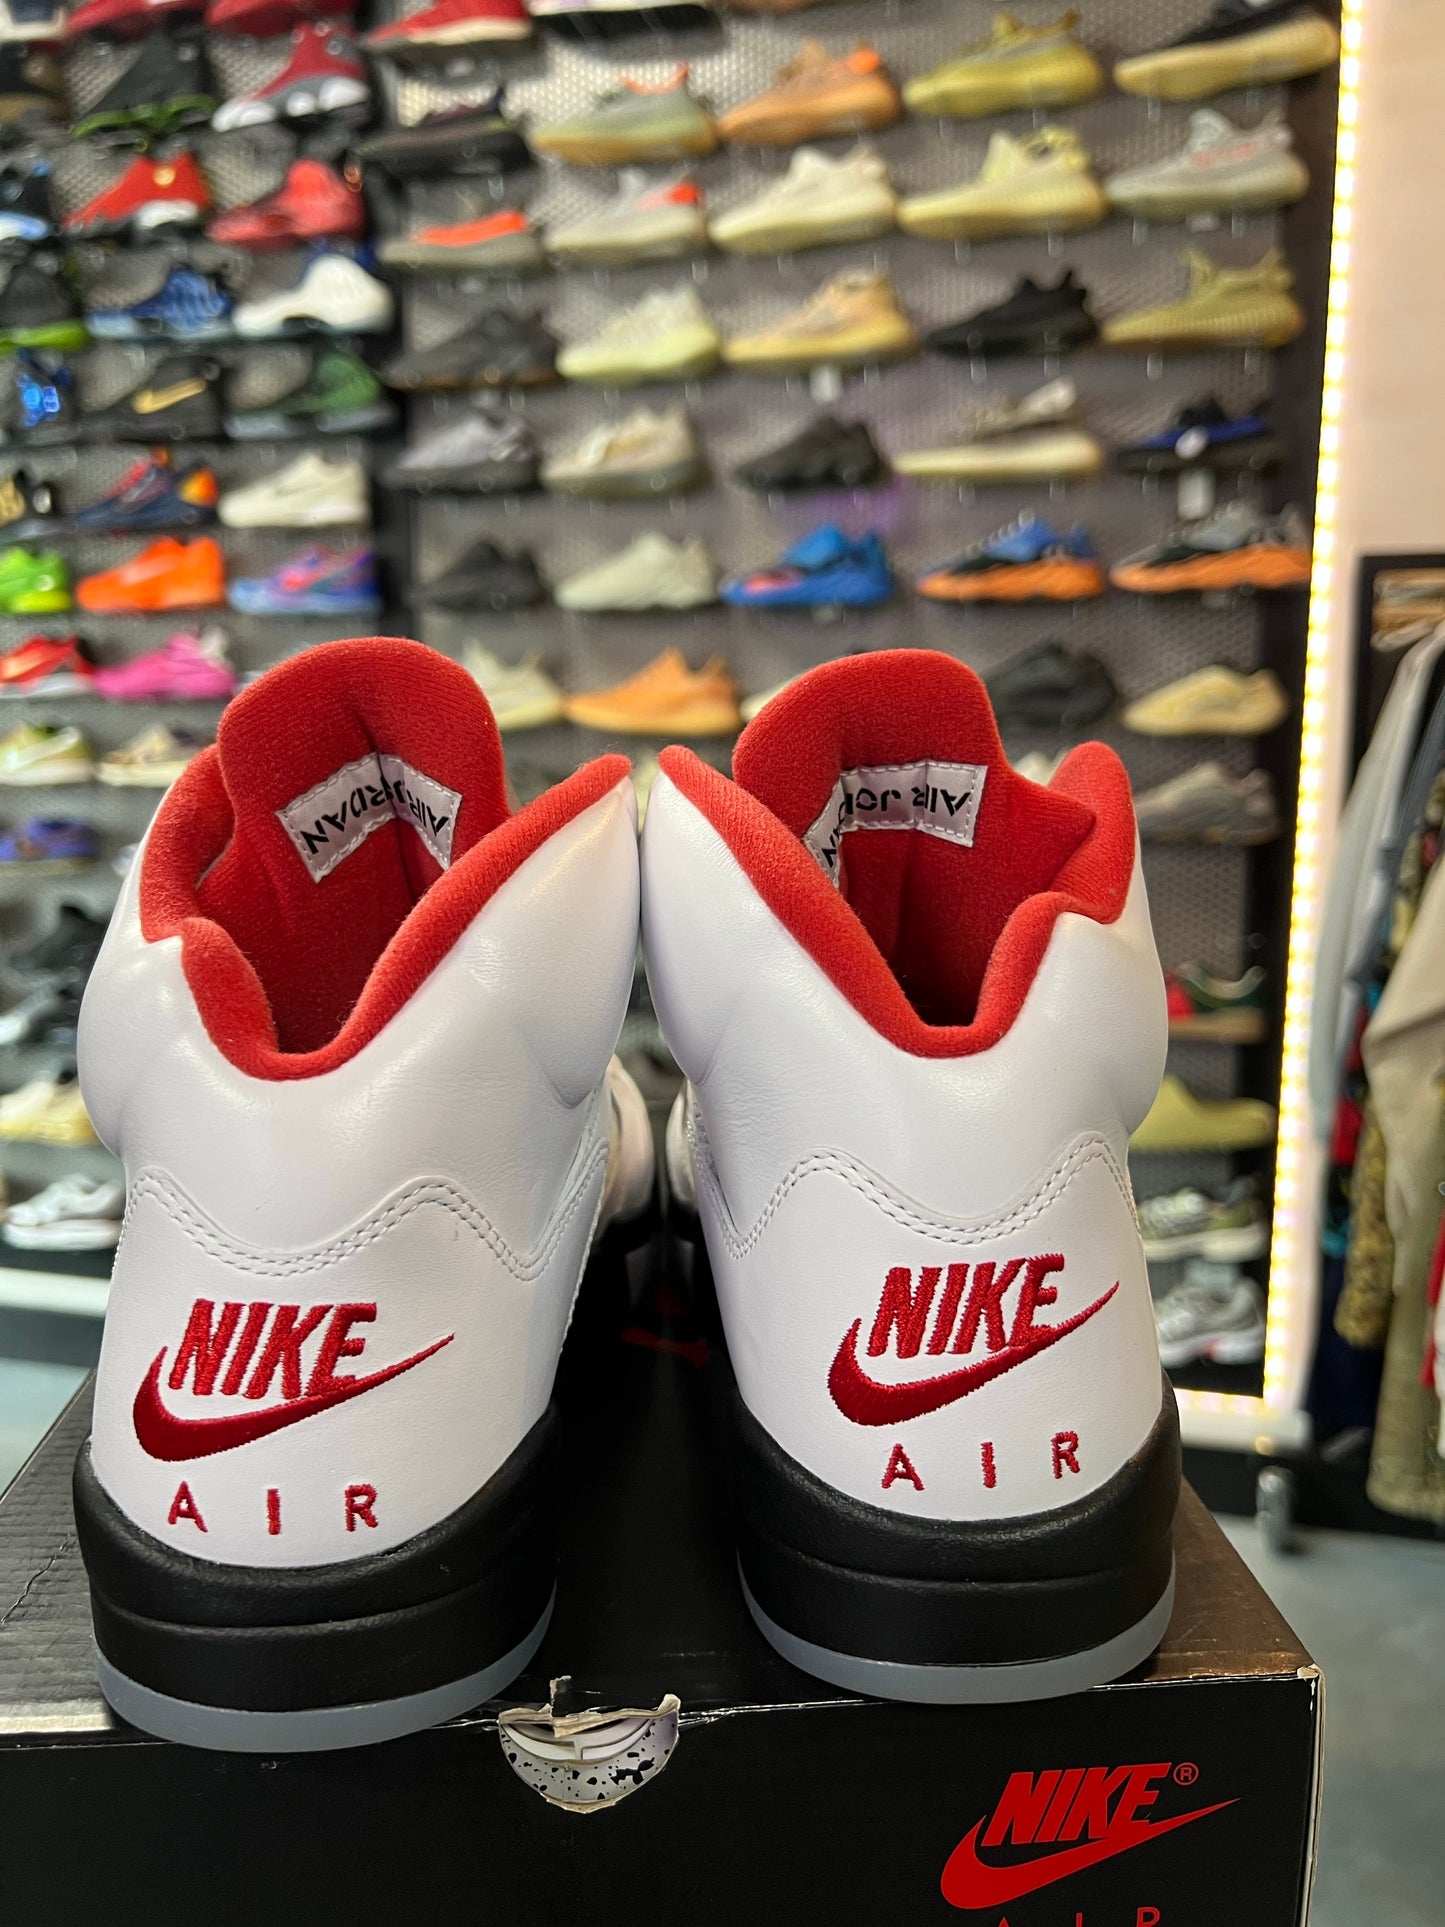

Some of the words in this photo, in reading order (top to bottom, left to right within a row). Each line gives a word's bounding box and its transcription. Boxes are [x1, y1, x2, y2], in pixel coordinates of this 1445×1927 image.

[407, 789, 450, 837] AIR
[910, 784, 971, 817] AIR
[866, 1253, 1065, 1359] NIKE
[168, 1298, 378, 1400] NIKE
[881, 1430, 1081, 1491] AIR
[167, 1480, 379, 1536] AIR
